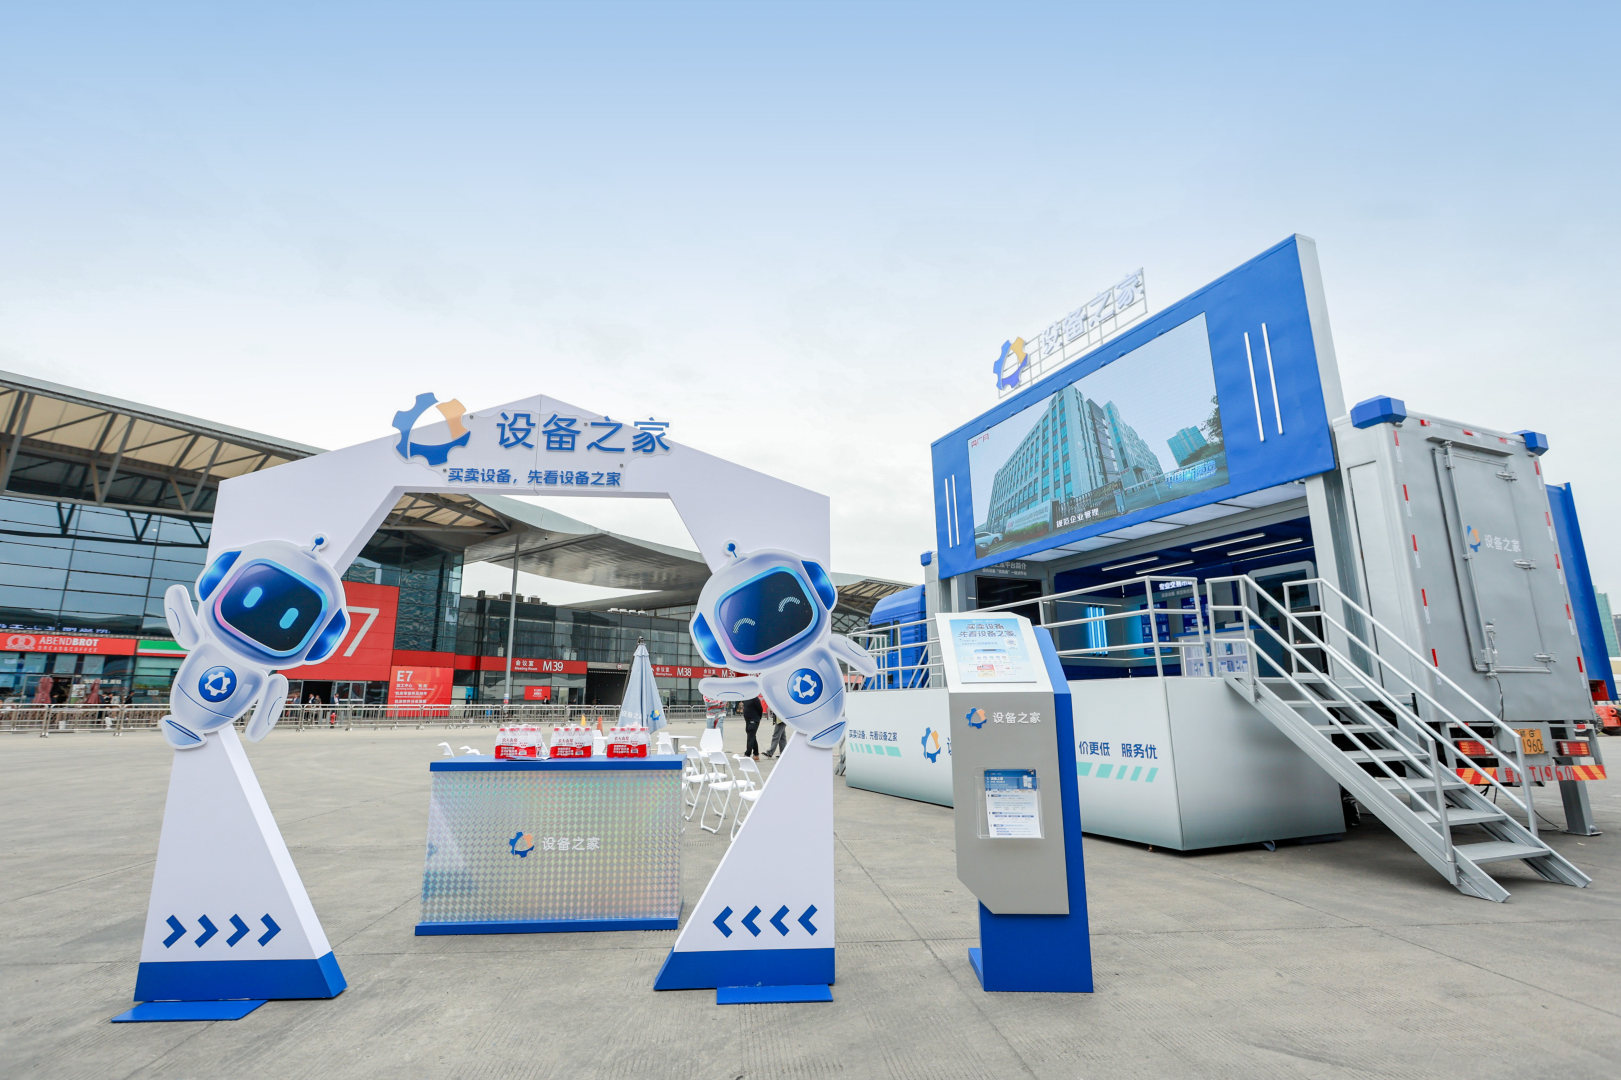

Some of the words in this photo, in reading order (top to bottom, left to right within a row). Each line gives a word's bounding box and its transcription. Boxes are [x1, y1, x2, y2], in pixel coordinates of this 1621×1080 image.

[1040, 271, 1143, 354] 设备之家
[496, 411, 671, 454] 设备之家
[448, 467, 622, 487] 买卖设备，先看设备之家
[1484, 534, 1521, 553] 设备之家
[39, 636, 99, 647] ABENDBROT
[543, 660, 564, 672] M39
[677, 667, 692, 677] M38
[396, 670, 414, 682] E7
[992, 711, 1041, 724] 设备之家
[1079, 741, 1111, 757] 价更低
[1121, 743, 1158, 760] 服务优
[542, 836, 600, 851] 设备之家
